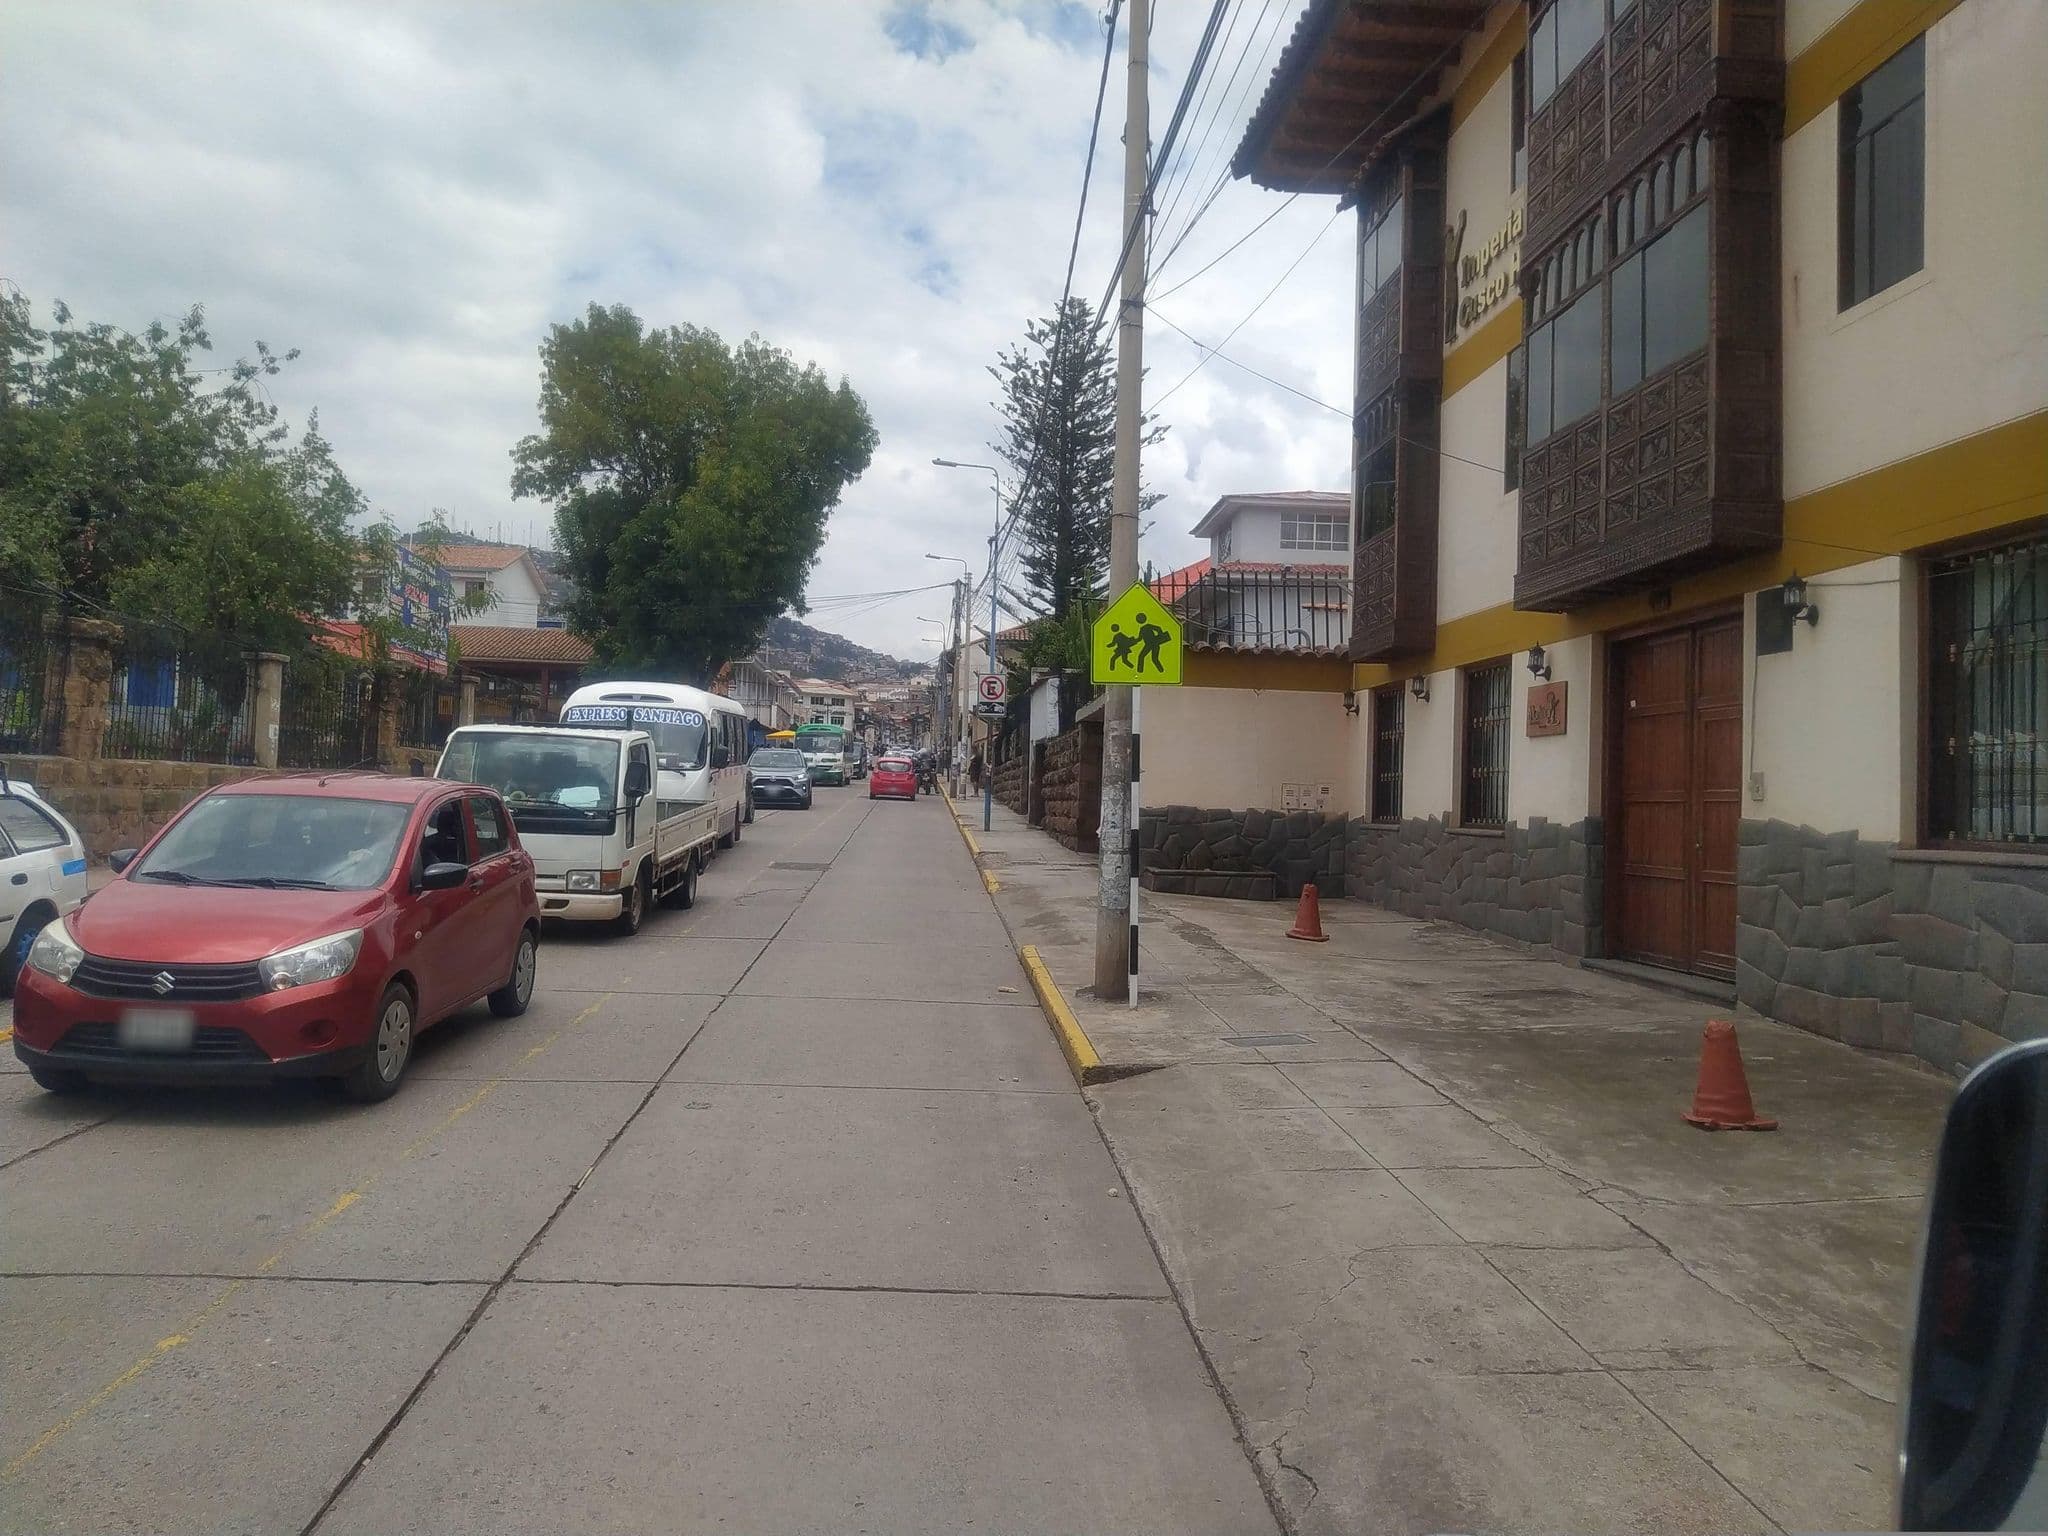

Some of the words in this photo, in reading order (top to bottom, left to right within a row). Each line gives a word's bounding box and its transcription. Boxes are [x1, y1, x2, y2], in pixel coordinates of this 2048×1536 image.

[987, 680, 998, 696] E
[568, 707, 628, 721] EXPRESO
[633, 707, 703, 726] SANTIAGO
